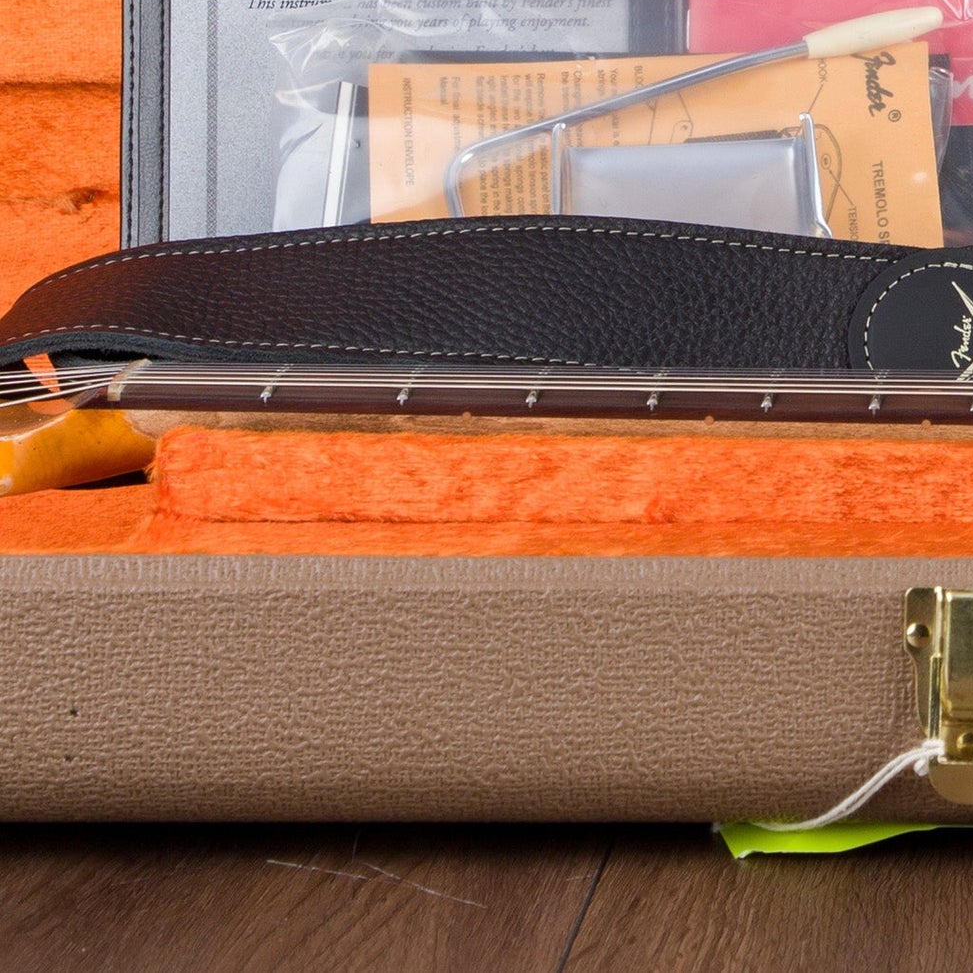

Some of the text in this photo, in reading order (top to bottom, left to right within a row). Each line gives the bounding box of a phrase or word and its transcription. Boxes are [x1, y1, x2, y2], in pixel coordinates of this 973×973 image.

[520, 17, 590, 32] enjoyment.
[850, 52, 896, 116] Fender
[402, 78, 414, 186] INSTRUCTION ENVELOPE
[872, 161, 887, 227] TREMOLO
[951, 315, 971, 368] Fender
